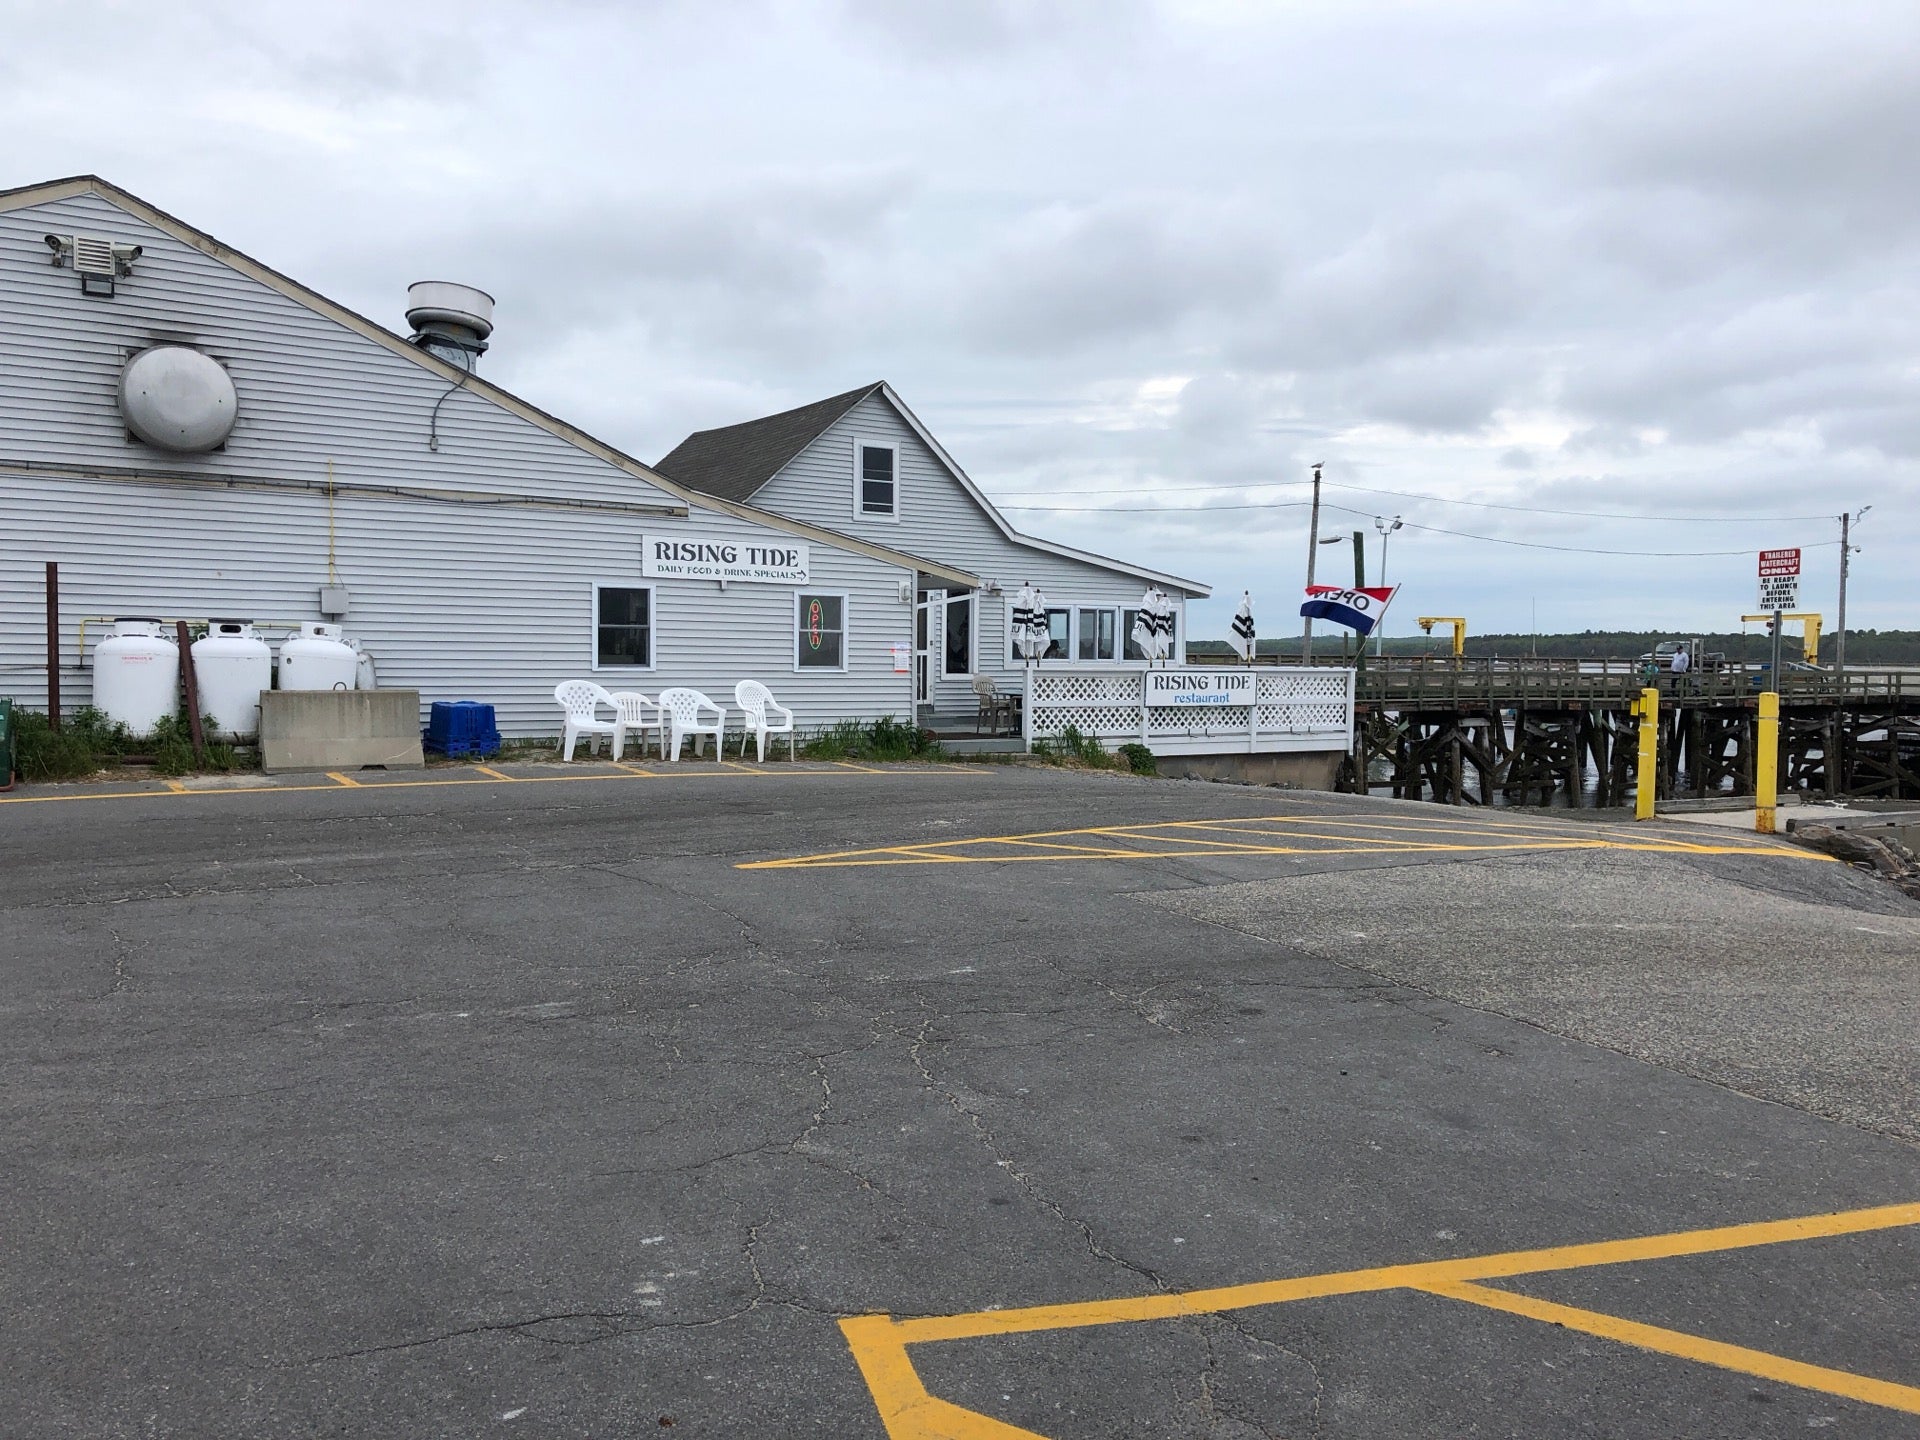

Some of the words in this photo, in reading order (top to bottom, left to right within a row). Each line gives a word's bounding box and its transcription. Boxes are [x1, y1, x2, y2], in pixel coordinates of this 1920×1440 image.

[654, 541, 738, 564] RISING
[746, 547, 799, 568] TIDE
[1765, 551, 1796, 559] TRAILERED
[1761, 558, 1799, 567] WATERCRAFT
[657, 564, 684, 573] DAILY
[687, 566, 712, 575] FOOD
[724, 568, 752, 577] DRINK
[754, 569, 797, 580] SPECIALS
[1761, 566, 1798, 575] ONLY
[811, 602, 819, 645] OPEN
[1153, 675, 1209, 690] RISING
[1214, 675, 1251, 690] TIDE
[1174, 692, 1230, 704] restaurant
